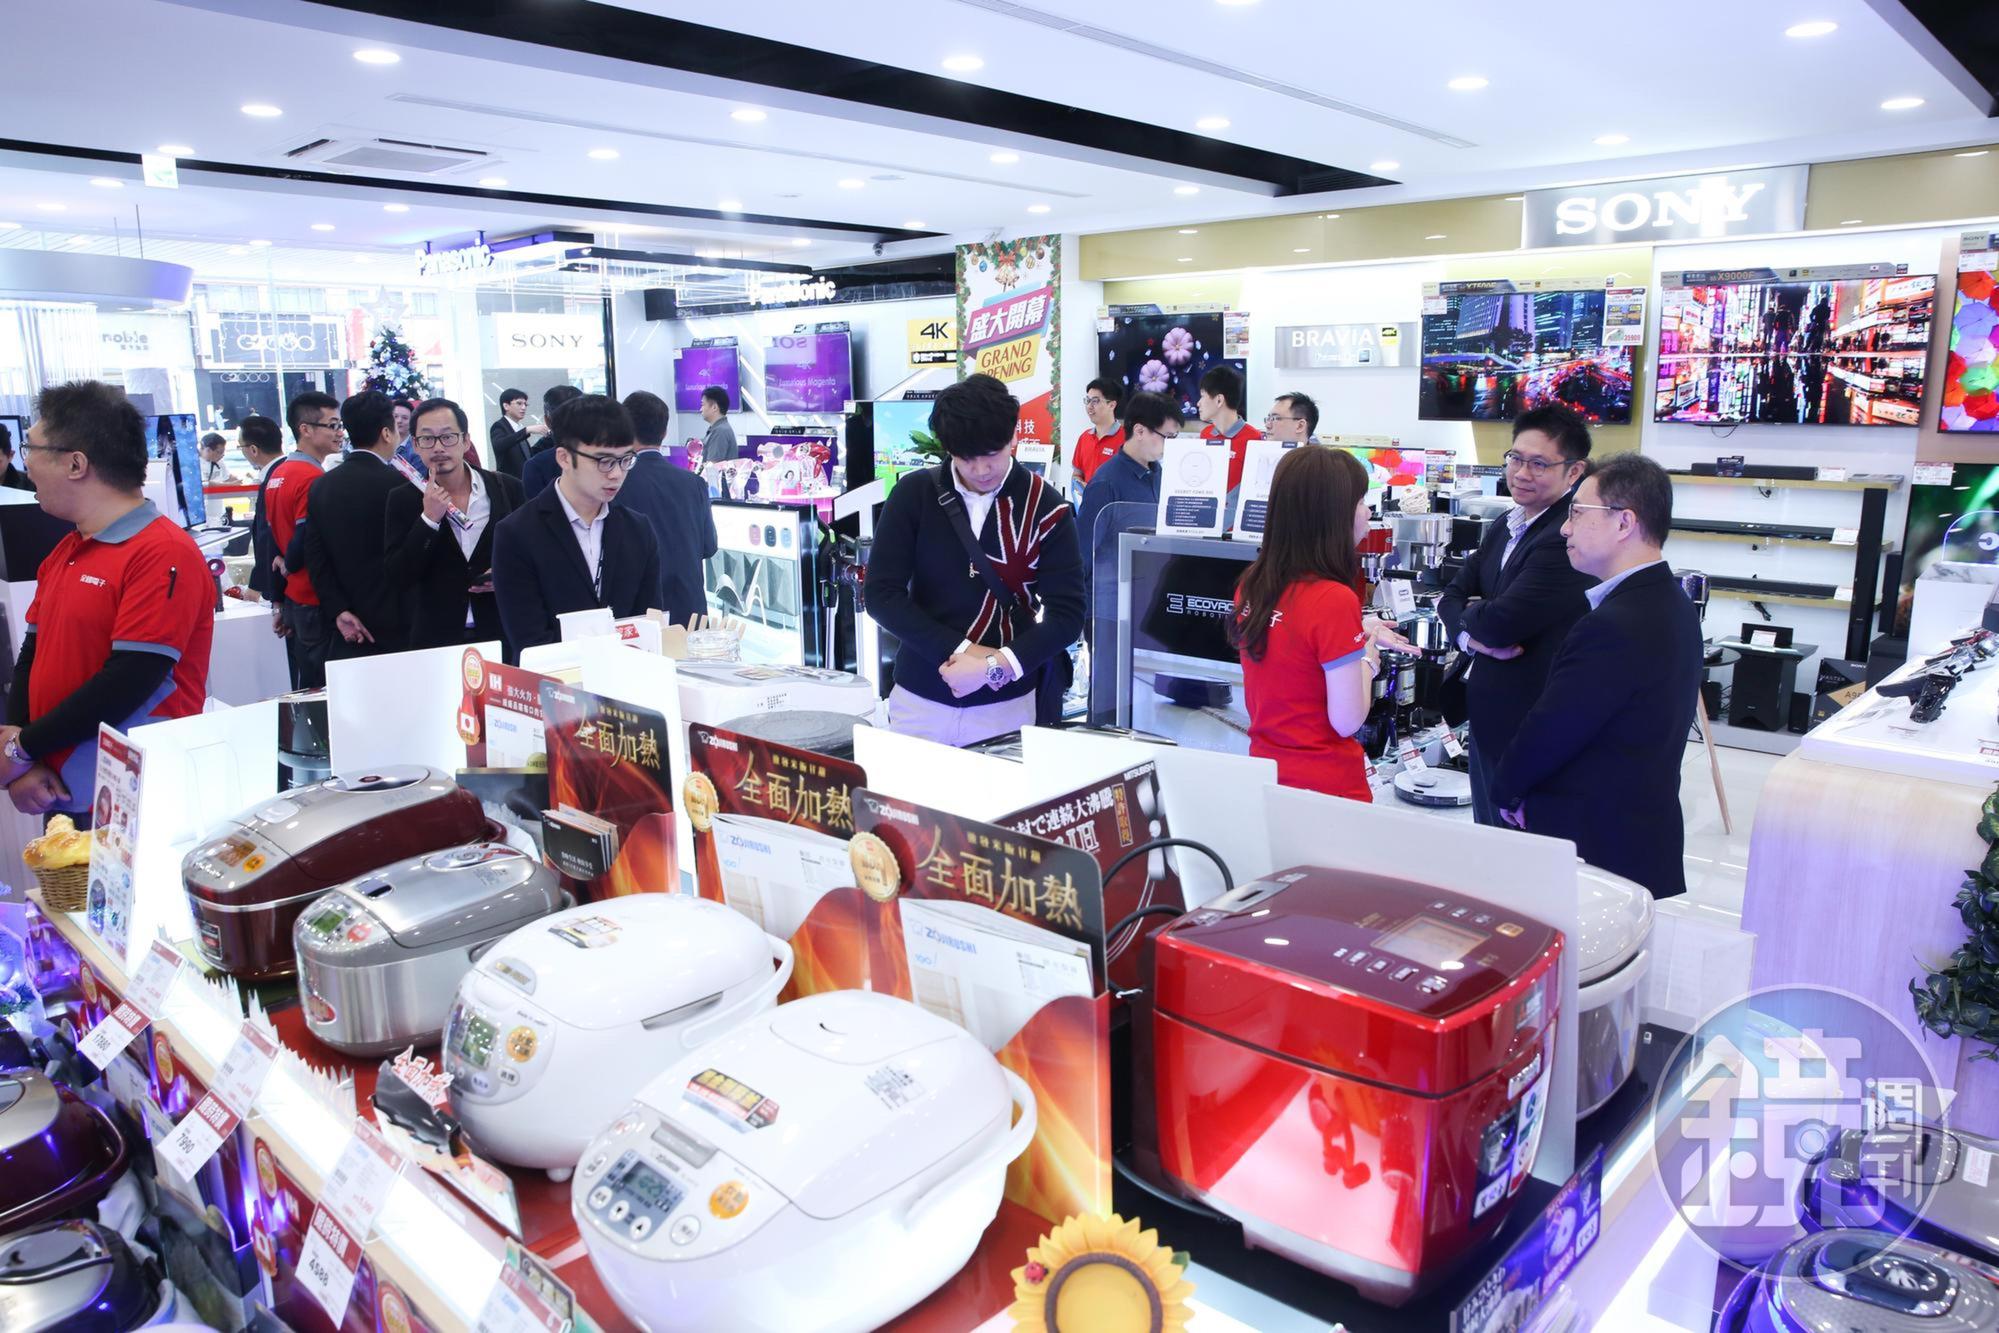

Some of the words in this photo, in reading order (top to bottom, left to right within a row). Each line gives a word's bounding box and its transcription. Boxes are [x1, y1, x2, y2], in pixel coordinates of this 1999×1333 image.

[1556, 182, 1766, 235] SONY
[414, 238, 494, 275] Panasonic
[750, 276, 836, 304] Panasonic
[920, 322, 949, 339] 4K
[969, 295, 1048, 344] 盛大開幕
[512, 333, 583, 348] SONY
[1291, 328, 1376, 348] BRAVIA
[981, 340, 1032, 369] GRAND
[220, 372, 270, 383] G2000
[980, 357, 1032, 381] PENING
[1187, 599, 1236, 612] ECOVAC
[489, 672, 502, 692] IH
[574, 702, 661, 771] 全面加熱
[733, 749, 854, 832] 全面加熱
[915, 824, 1084, 931] 全面加熱
[925, 927, 977, 954] ZOJIRUSHI
[175, 1132, 196, 1154] 7990
[308, 1257, 330, 1288] 4588
